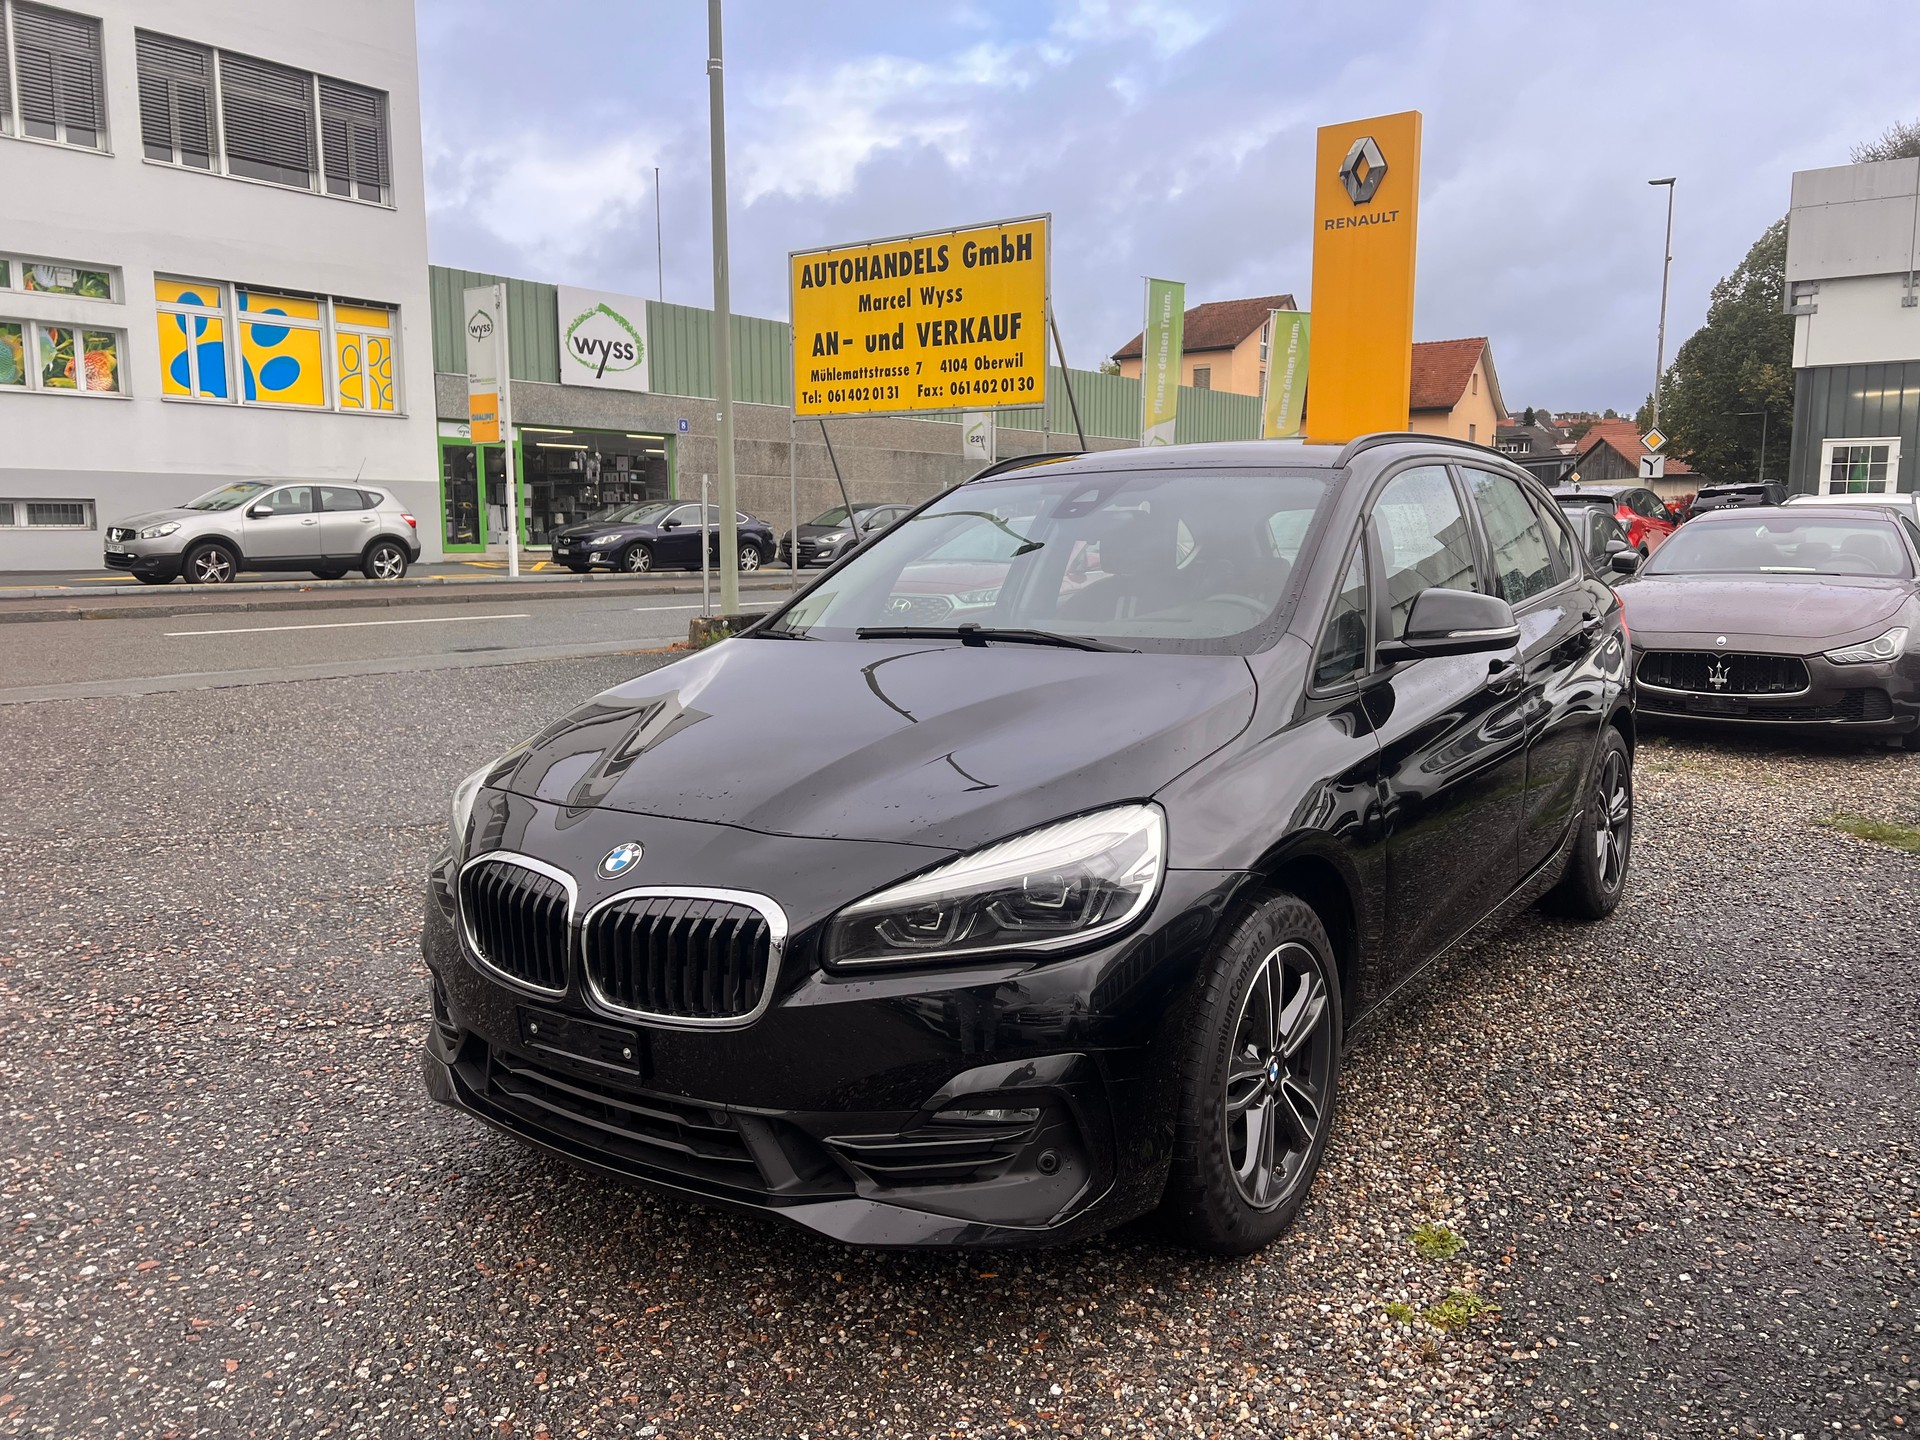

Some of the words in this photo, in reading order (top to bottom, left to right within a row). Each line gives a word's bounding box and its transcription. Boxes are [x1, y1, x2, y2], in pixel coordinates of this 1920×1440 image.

[1325, 210, 1399, 230] RENAULT
[801, 245, 949, 289] AUTOHANDELS
[962, 233, 1032, 268] GmbH
[858, 288, 911, 312] Marcel
[920, 286, 963, 308] Wyss
[1161, 291, 1171, 328] Traum.
[470, 323, 491, 343] wyss
[865, 322, 904, 353] und
[917, 312, 1022, 347] VERKAUF
[1287, 320, 1300, 354] Traum.
[573, 336, 634, 379] wyss
[811, 365, 910, 382] Mühlemattstrasse
[916, 361, 923, 375] 7
[940, 358, 968, 373] 4104
[974, 352, 1024, 371] Oberwil
[1158, 332, 1169, 370] deinen
[1283, 357, 1296, 390] deinen
[802, 390, 822, 404] Tel:
[917, 384, 943, 397] Fax:
[1154, 373, 1166, 414] Pflanze
[1277, 393, 1291, 430] Pflanze
